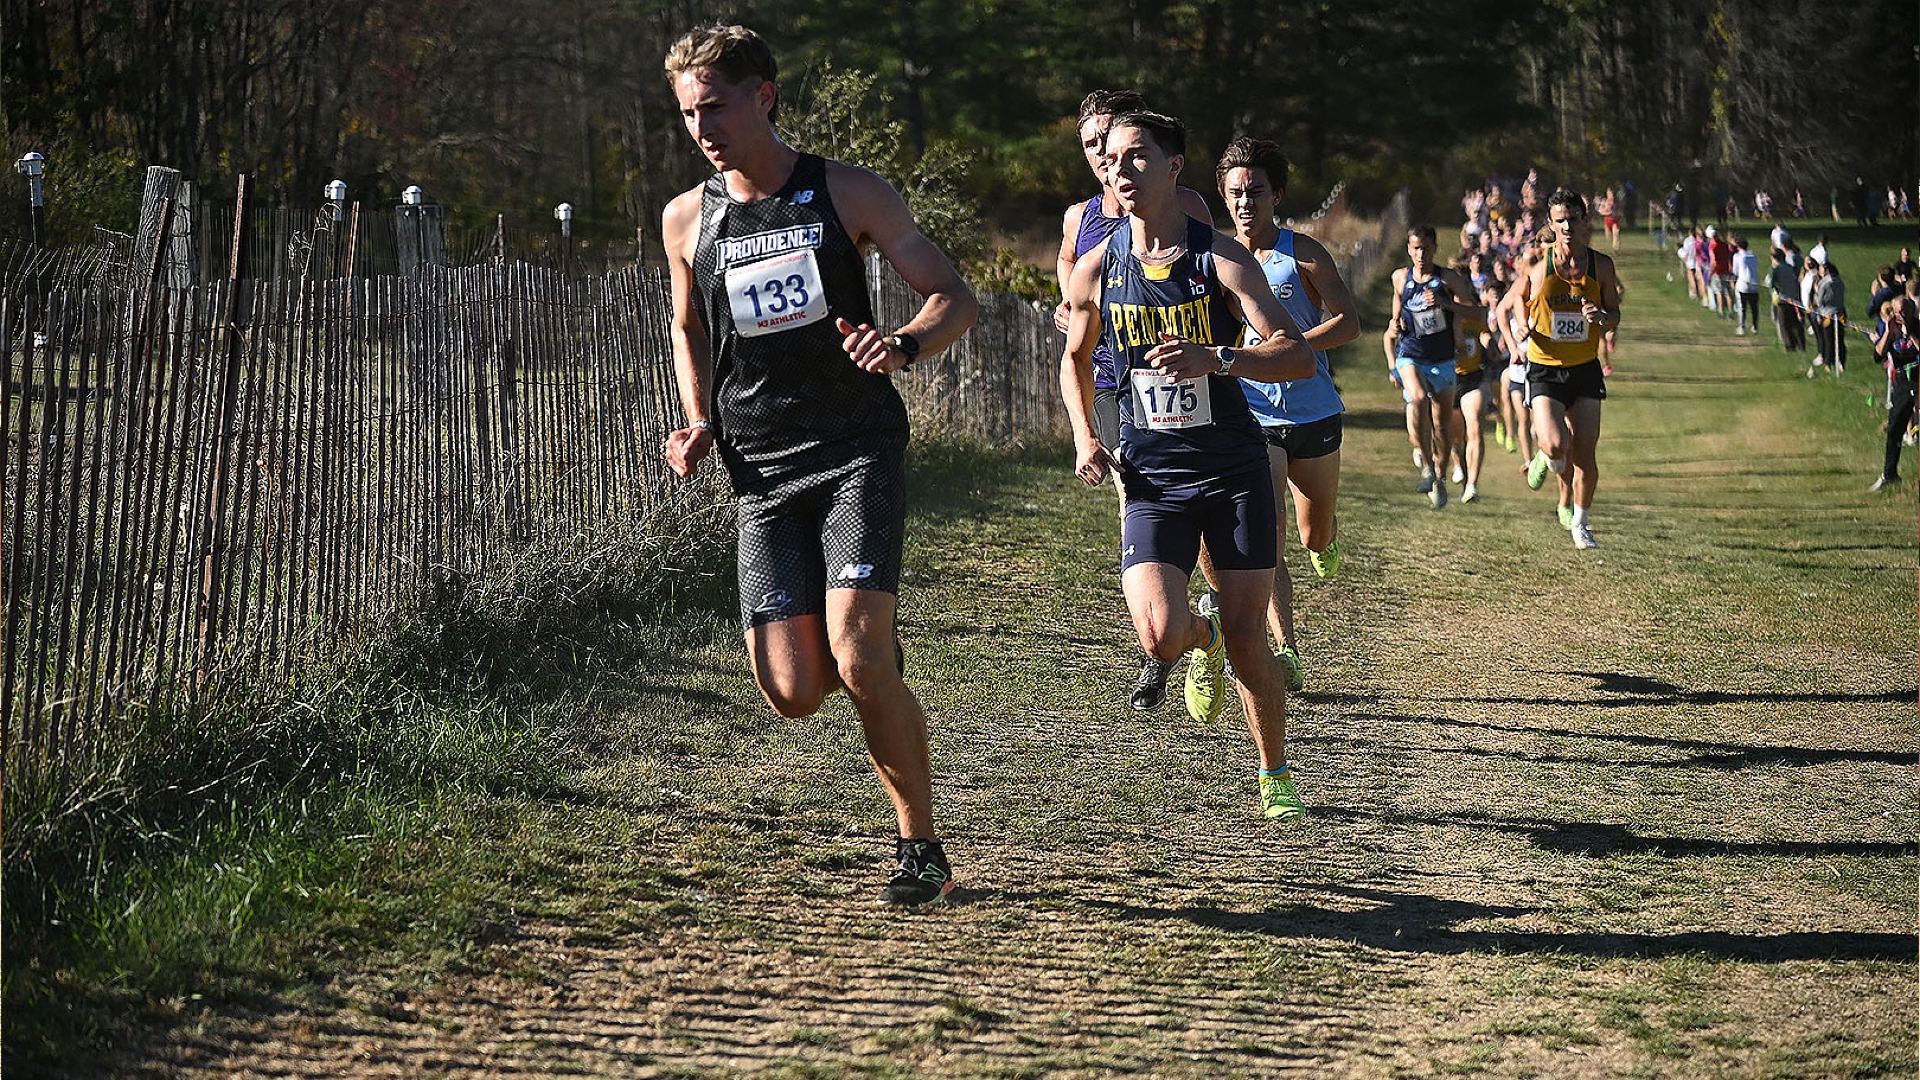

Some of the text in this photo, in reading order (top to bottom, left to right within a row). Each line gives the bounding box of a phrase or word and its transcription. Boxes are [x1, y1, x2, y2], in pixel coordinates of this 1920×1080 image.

[719, 227, 820, 271] PROVIDENCE
[743, 274, 809, 318] 133
[770, 311, 806, 326] ATHLETIC
[1108, 295, 1214, 352] PENMEN
[1557, 320, 1584, 335] 284
[1144, 383, 1198, 413] 175
